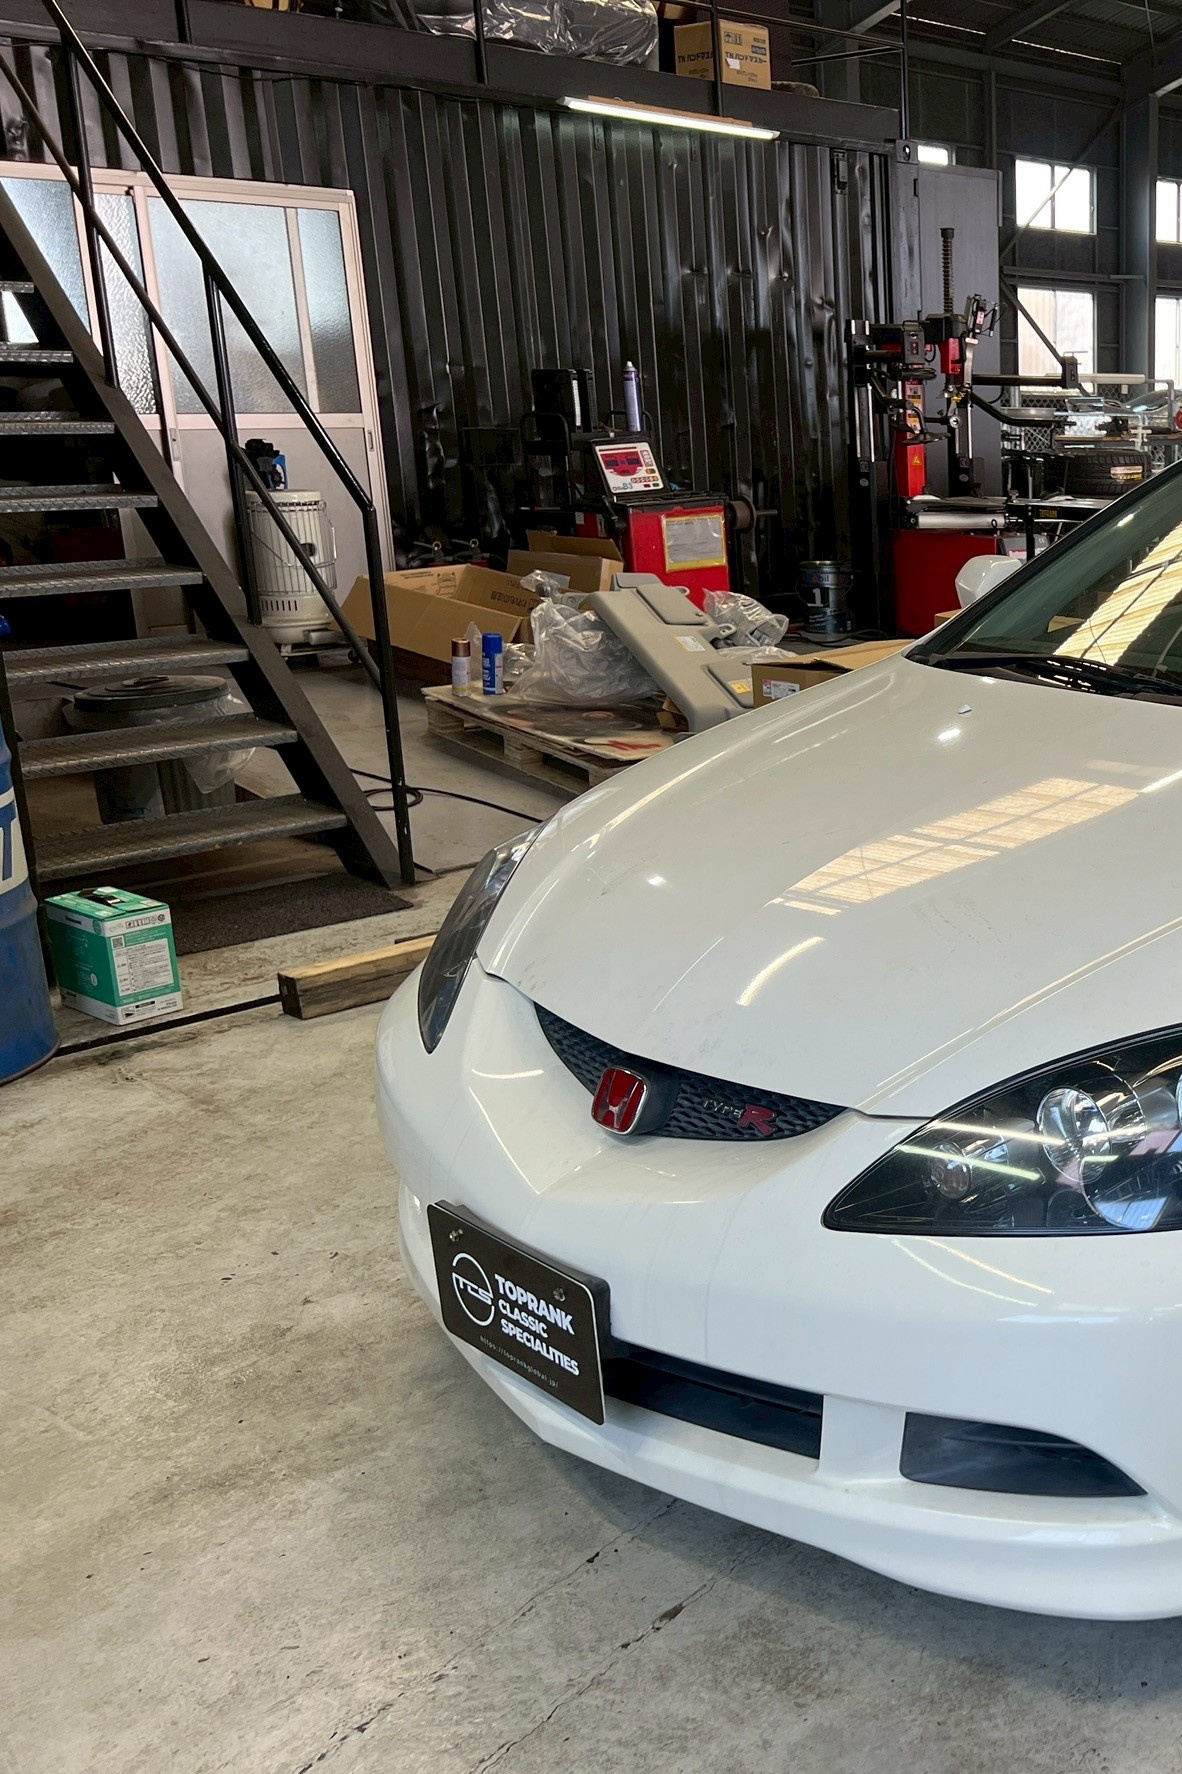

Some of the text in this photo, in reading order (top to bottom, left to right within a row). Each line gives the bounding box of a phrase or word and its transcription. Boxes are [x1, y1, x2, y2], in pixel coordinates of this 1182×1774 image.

[702, 1098, 777, 1136] TYPE R
[494, 1273, 576, 1336] TOPRANK
[498, 1298, 549, 1339] CLASSIC
[501, 1319, 580, 1377] SPECIALITIES
